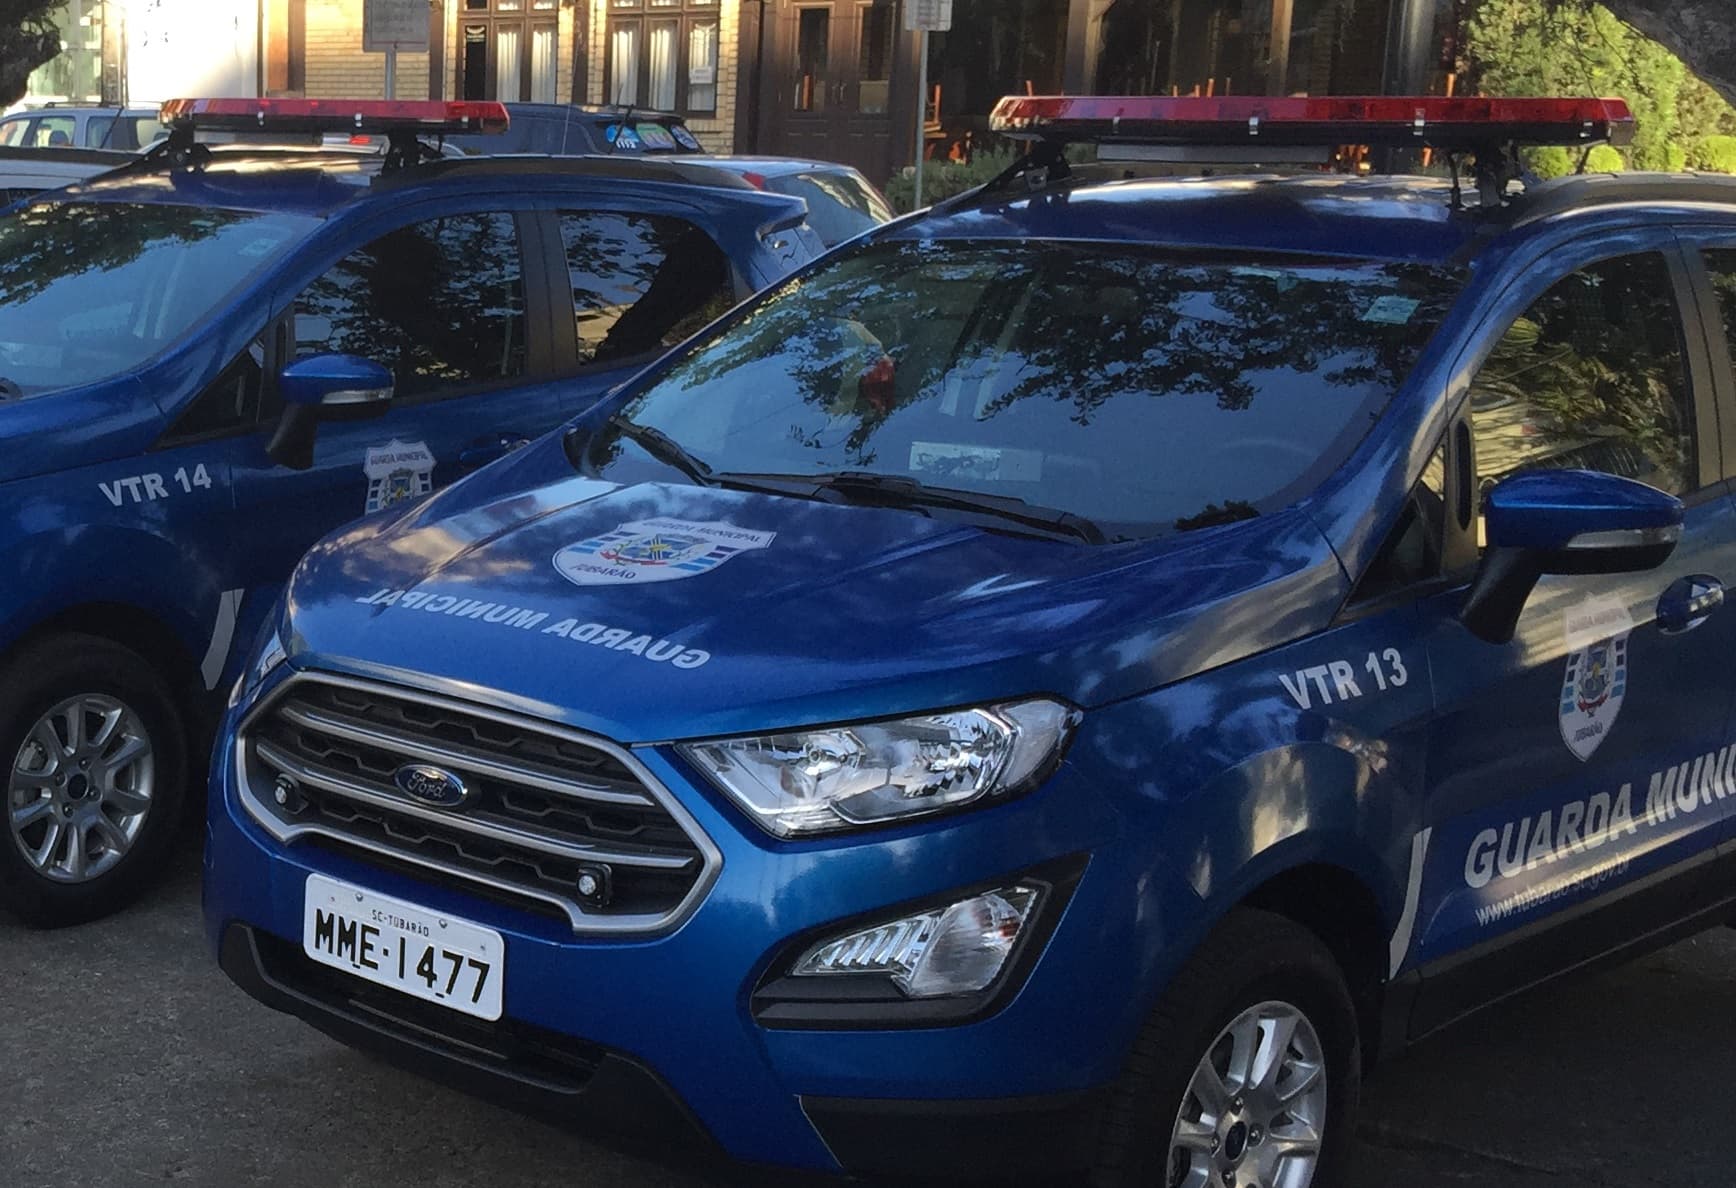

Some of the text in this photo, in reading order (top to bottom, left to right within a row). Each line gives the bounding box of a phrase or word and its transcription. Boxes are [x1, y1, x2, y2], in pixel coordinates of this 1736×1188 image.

[98, 463, 212, 508] VTR 14
[1278, 647, 1408, 710] VTR 13
[406, 769, 449, 799] Ford
[1464, 783, 1638, 888] GUARDA
